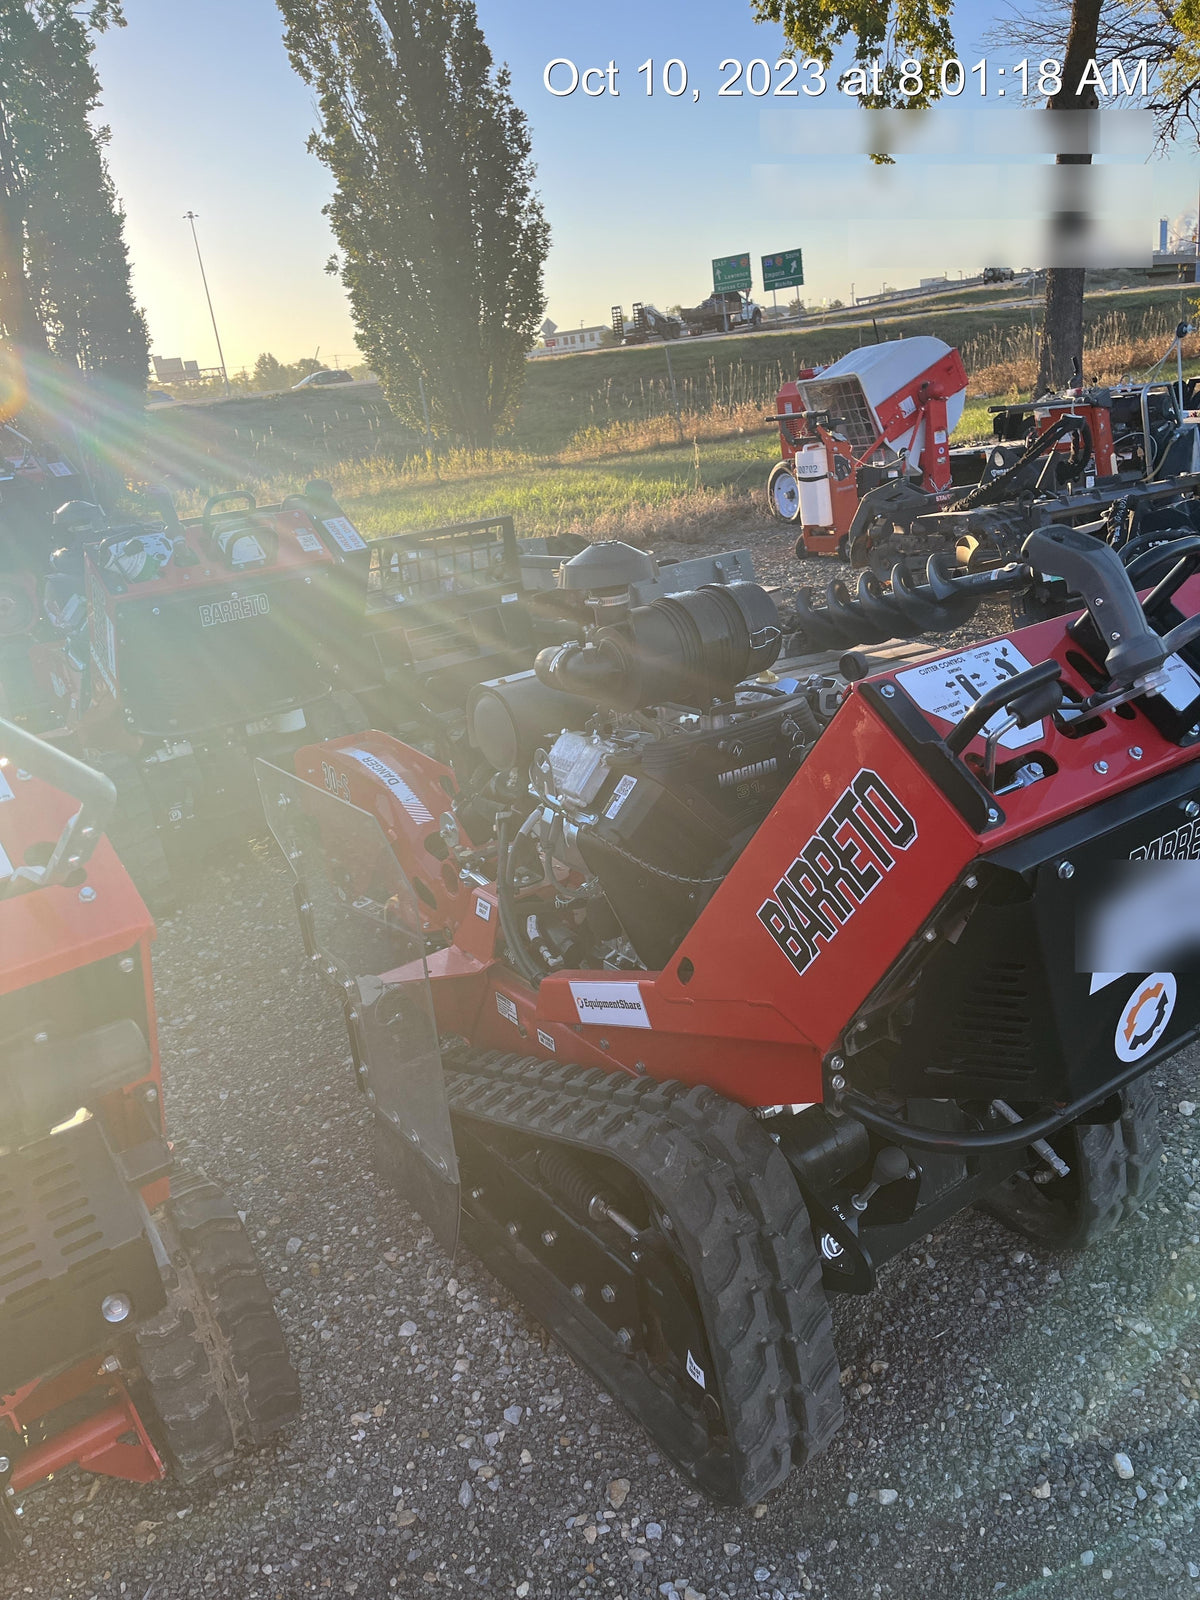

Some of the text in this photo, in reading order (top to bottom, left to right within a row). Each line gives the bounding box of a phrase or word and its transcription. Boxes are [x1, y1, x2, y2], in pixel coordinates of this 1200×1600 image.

[717, 283, 736, 291] Kansas
[725, 272, 749, 280] Lawrence
[199, 593, 270, 627] BARRETO
[919, 657, 965, 675] CUTTER CONTROL
[362, 756, 400, 786] DANGER
[718, 757, 777, 786] VANGUARD
[756, 767, 918, 976] BARRETO
[583, 998, 641, 1010] EquipmentShare
